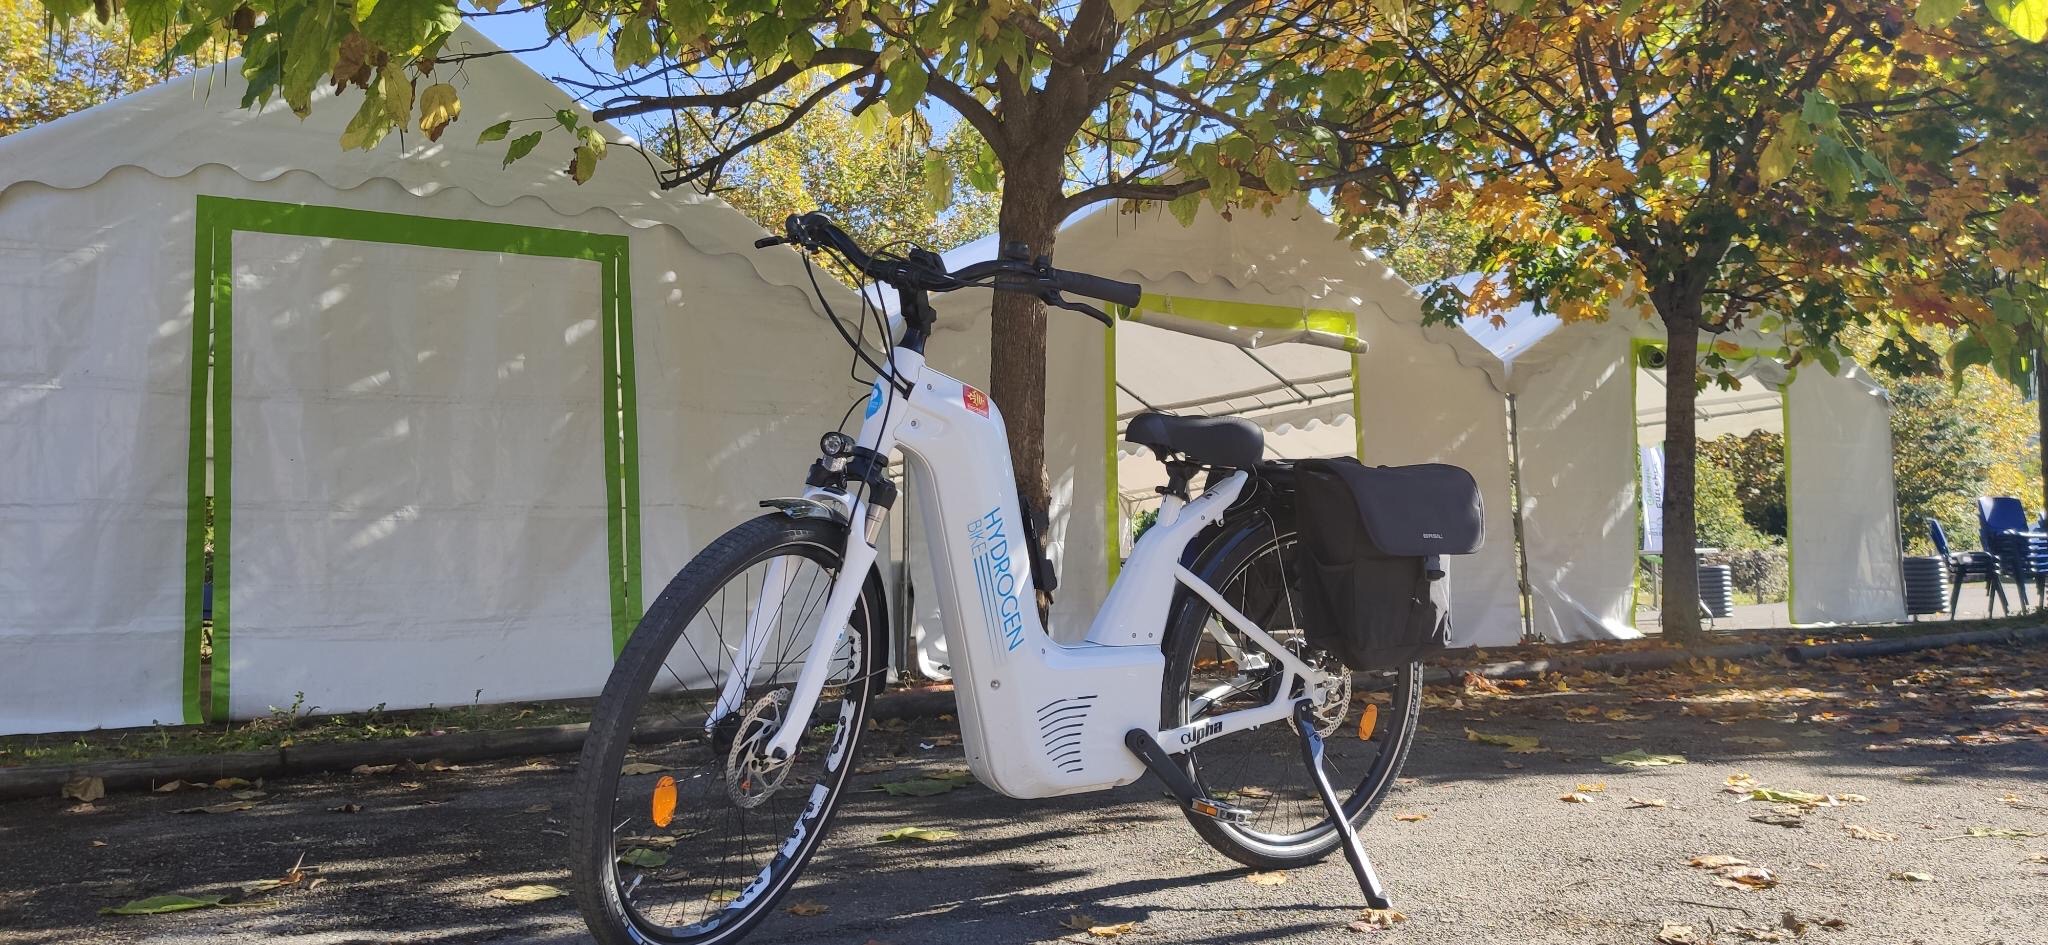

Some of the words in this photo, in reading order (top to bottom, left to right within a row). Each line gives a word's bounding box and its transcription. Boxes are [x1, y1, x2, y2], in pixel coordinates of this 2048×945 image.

[967, 519, 987, 556] BIKE
[984, 507, 1025, 651] HYDROGEN
[1181, 721, 1223, 744] alpha
